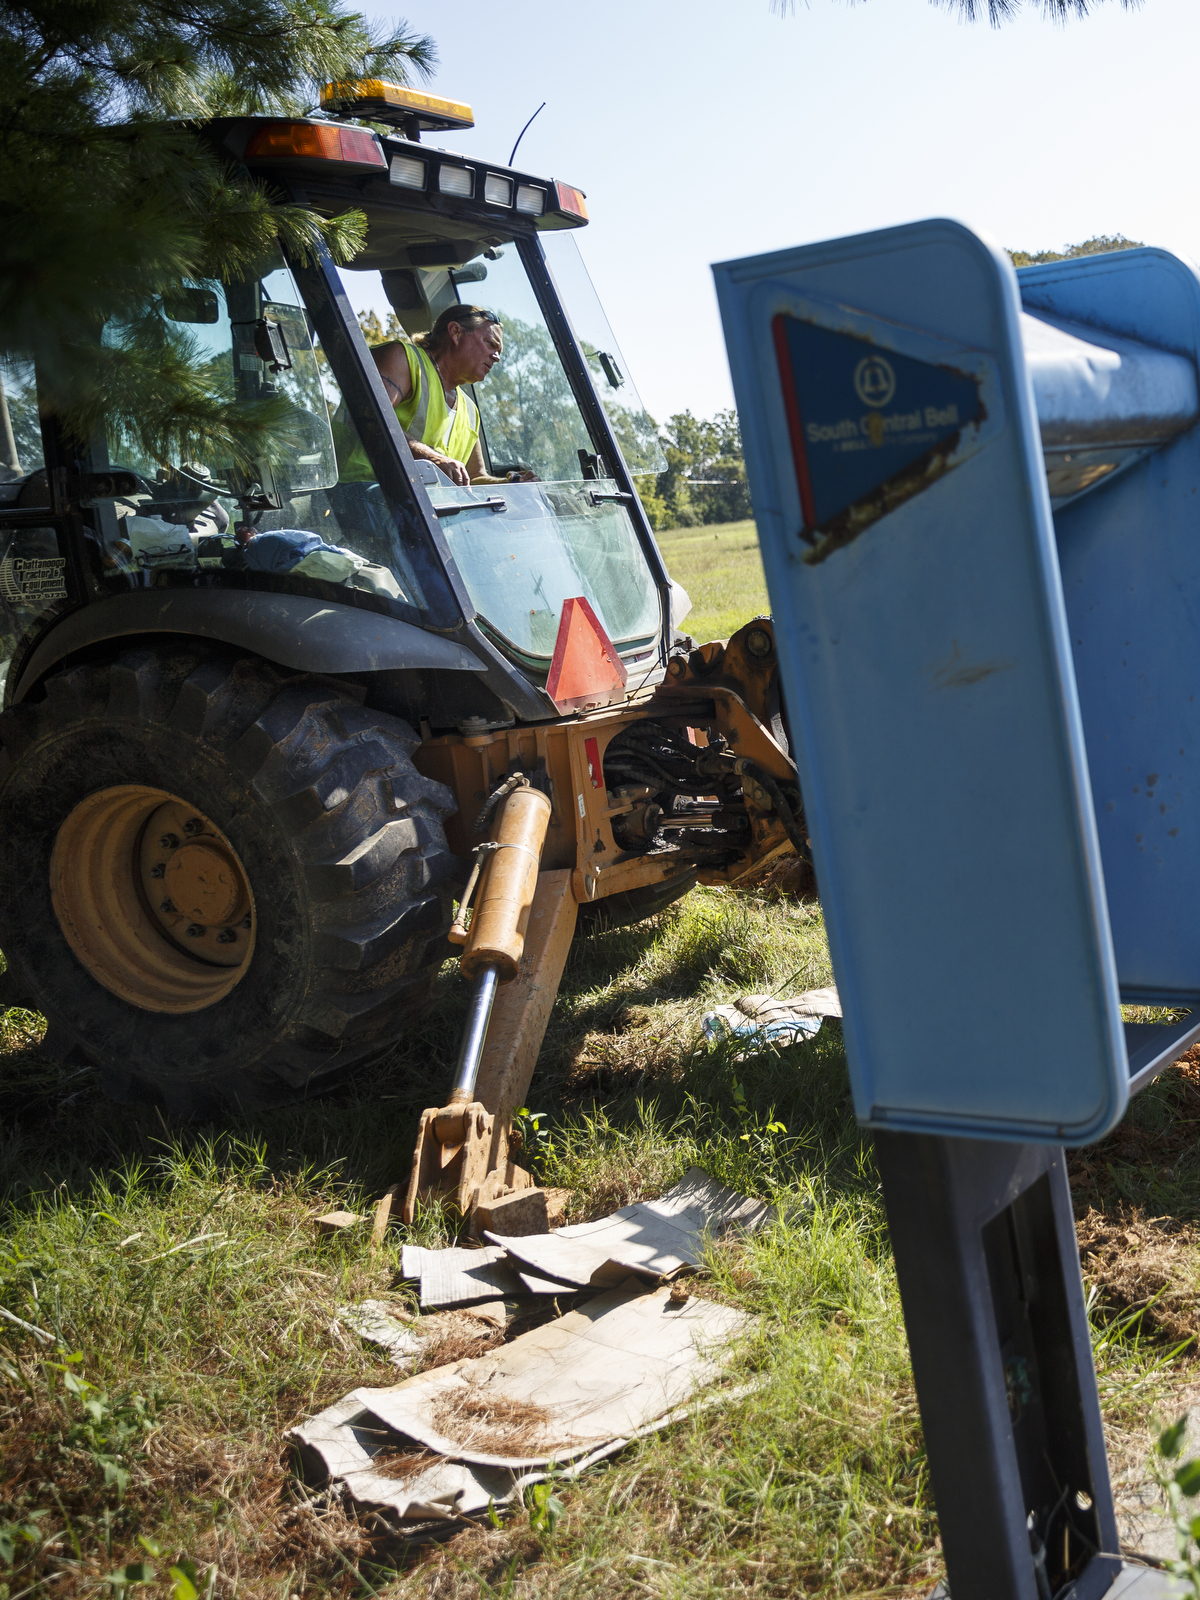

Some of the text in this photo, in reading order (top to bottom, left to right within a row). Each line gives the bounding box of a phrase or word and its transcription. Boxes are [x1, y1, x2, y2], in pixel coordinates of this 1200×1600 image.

[807, 419, 858, 443] South
[924, 405, 959, 427] Bell
[13, 558, 65, 570] Chattanooga
[18, 569, 51, 582] Tractor
[22, 576, 65, 593] Equipment
